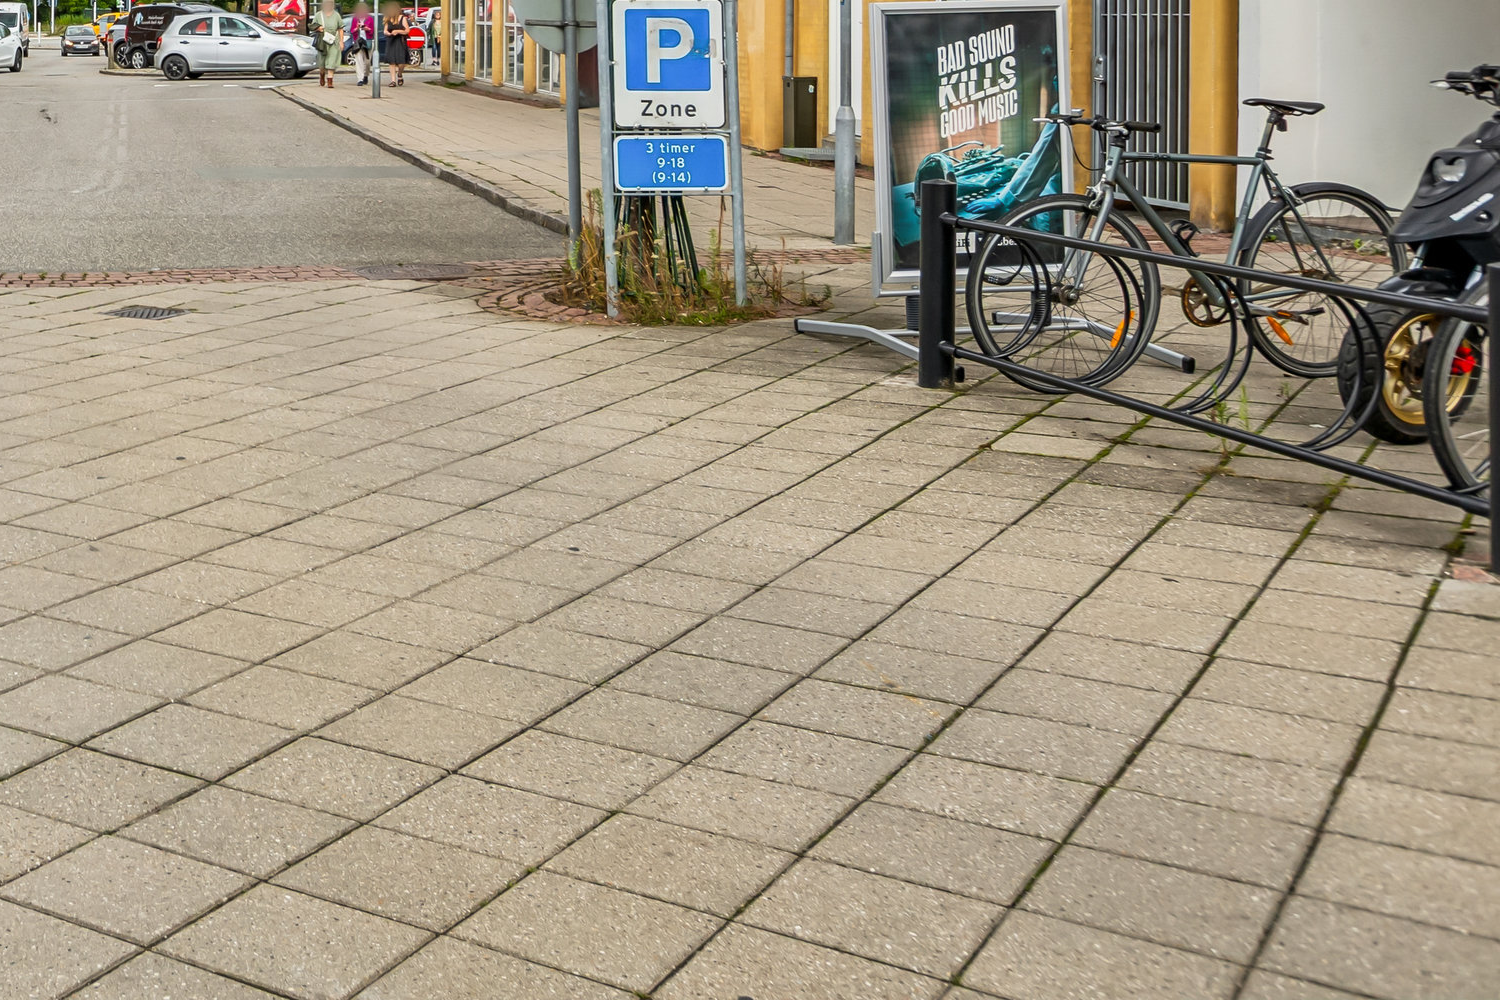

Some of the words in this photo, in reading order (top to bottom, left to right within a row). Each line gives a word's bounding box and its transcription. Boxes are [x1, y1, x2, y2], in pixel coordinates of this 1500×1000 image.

[645, 17, 695, 84] P
[937, 40, 966, 76] BAD
[968, 24, 1015, 66] SOUND
[938, 55, 1017, 110] KILLS
[640, 99, 697, 118] Zone
[940, 103, 975, 138] GOOD
[978, 89, 1018, 127] MUSIC
[645, 142, 654, 154] 3
[659, 142, 696, 154] timer
[657, 157, 685, 168] 9-18
[652, 171, 691, 184] (9-14)
